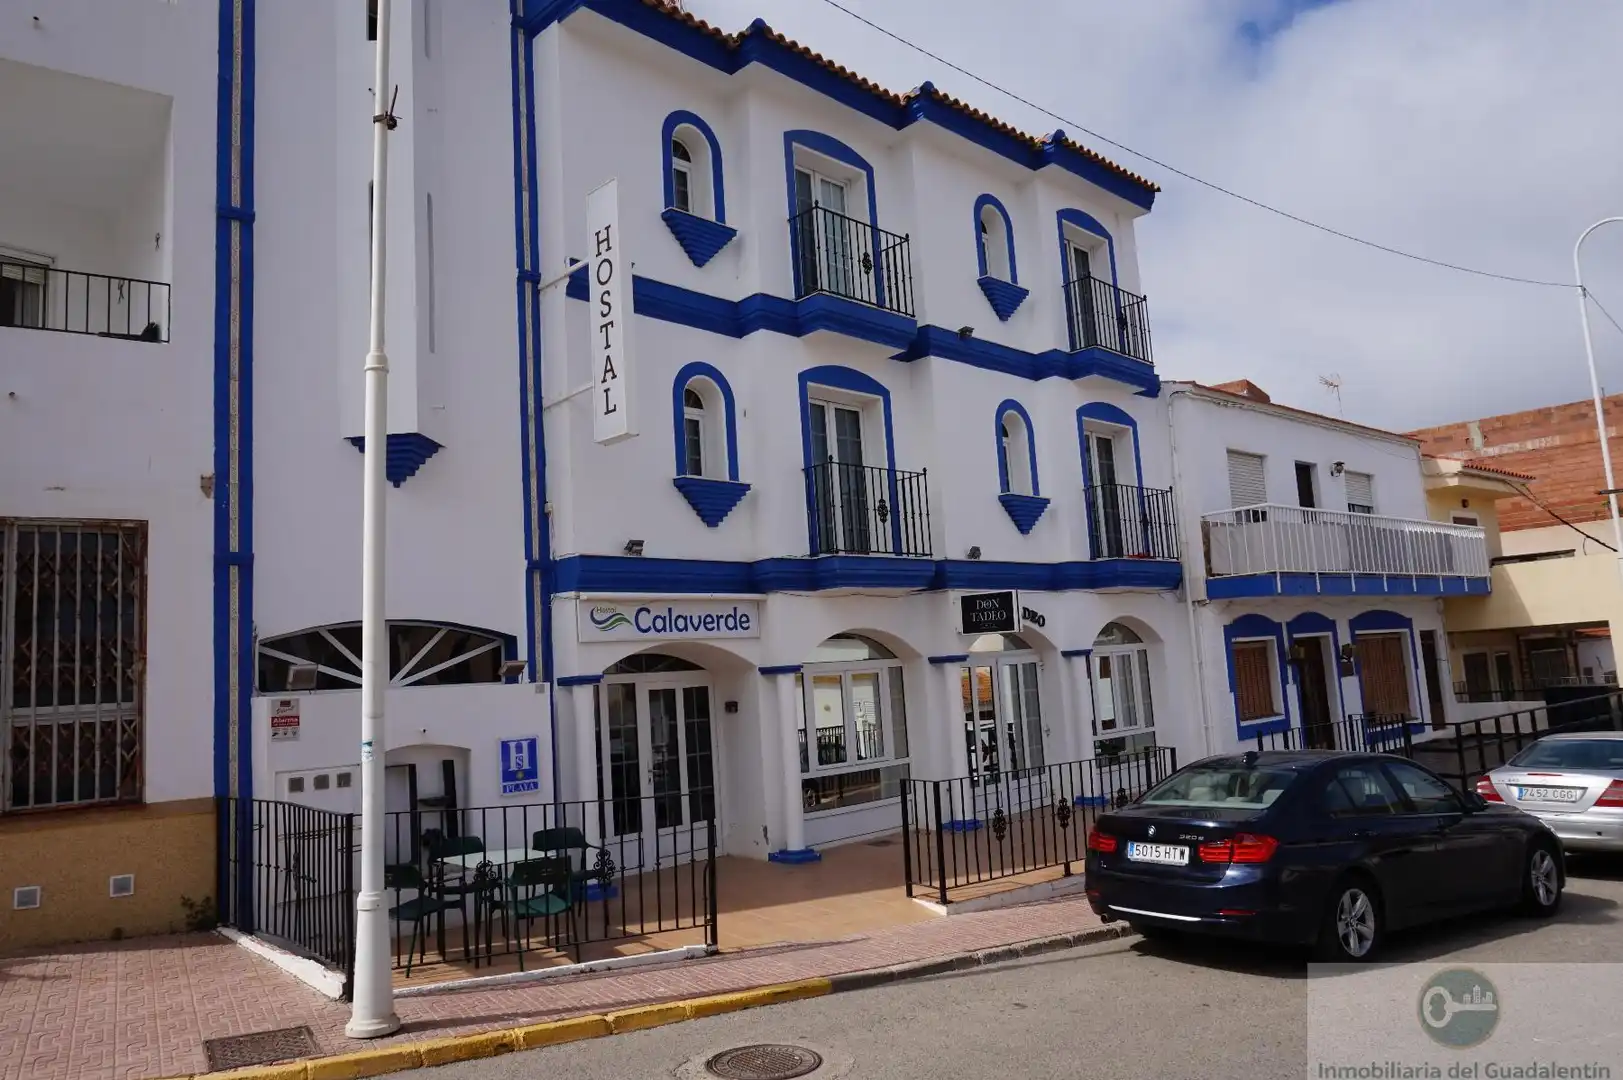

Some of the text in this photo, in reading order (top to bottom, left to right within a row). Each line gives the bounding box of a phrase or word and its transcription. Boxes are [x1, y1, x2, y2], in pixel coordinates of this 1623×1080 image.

[595, 224, 617, 416] HOSTAL
[976, 598, 1000, 610] DON
[634, 607, 751, 634] Calaverde
[970, 610, 1007, 622] TADEO
[506, 782, 536, 793] PLAYA
[1524, 788, 1548, 798] 7452
[1135, 845, 1185, 860] 5015 HTW
